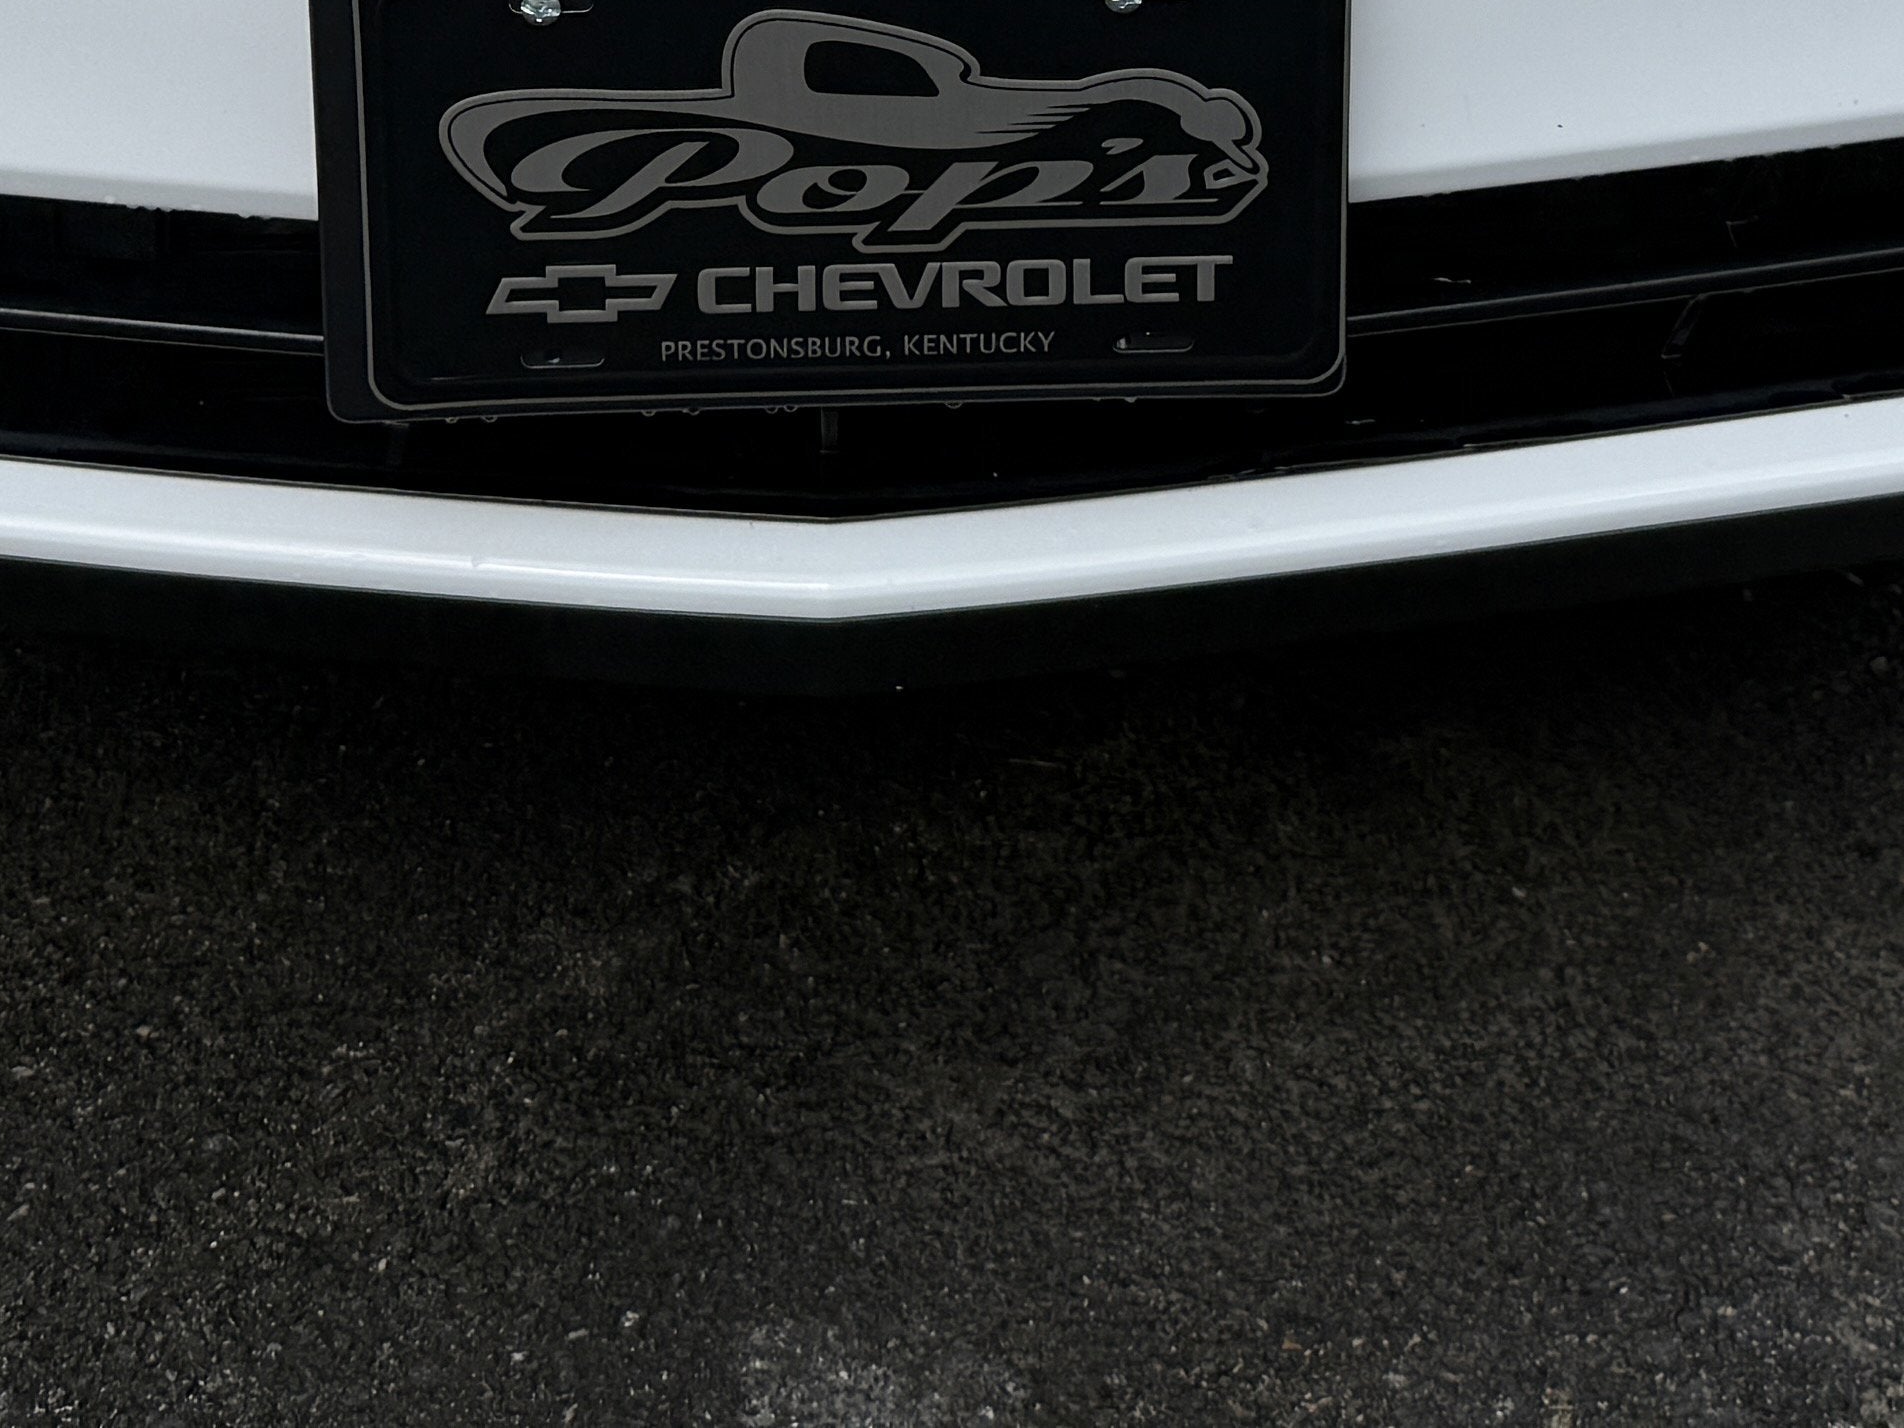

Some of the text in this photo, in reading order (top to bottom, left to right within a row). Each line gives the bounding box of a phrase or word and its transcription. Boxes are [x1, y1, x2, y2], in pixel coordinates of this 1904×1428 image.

[509, 127, 1220, 232] Pop's
[697, 255, 1234, 315] CHEVROLET
[660, 330, 1056, 363] PRESTONSBURG, KENTUCKY
